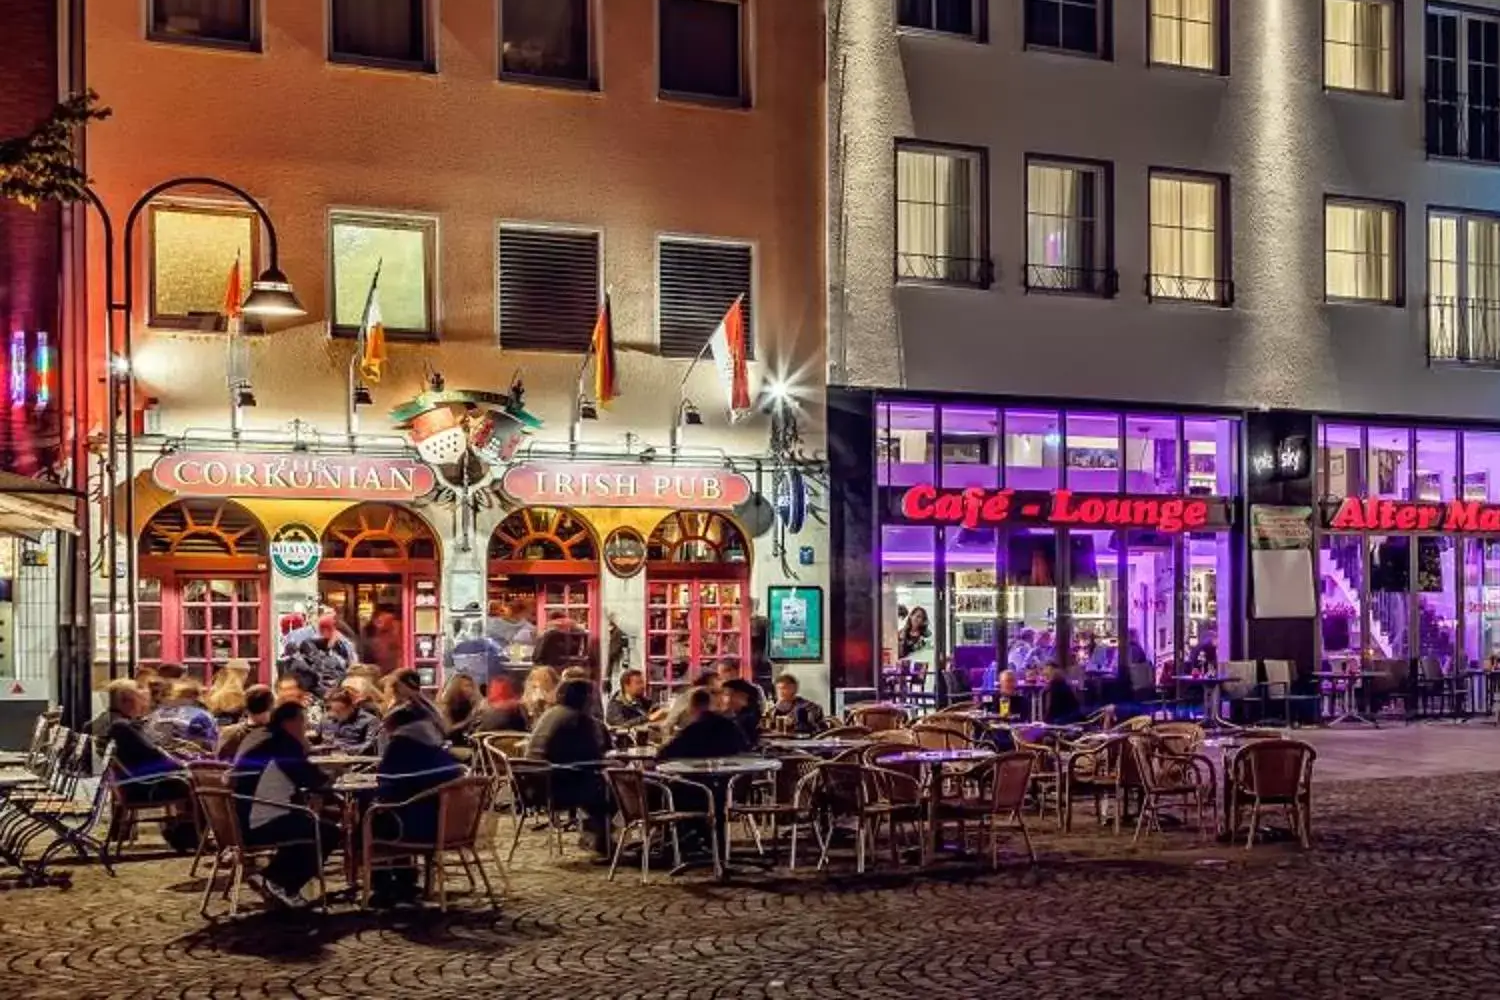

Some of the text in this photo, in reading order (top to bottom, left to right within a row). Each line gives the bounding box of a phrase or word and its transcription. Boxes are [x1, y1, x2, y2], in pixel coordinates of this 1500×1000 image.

[534, 471, 723, 499] IRISH PUB
[902, 484, 1015, 528] Café
[1049, 488, 1209, 532] Lounge
[1330, 496, 1437, 530] Alter
